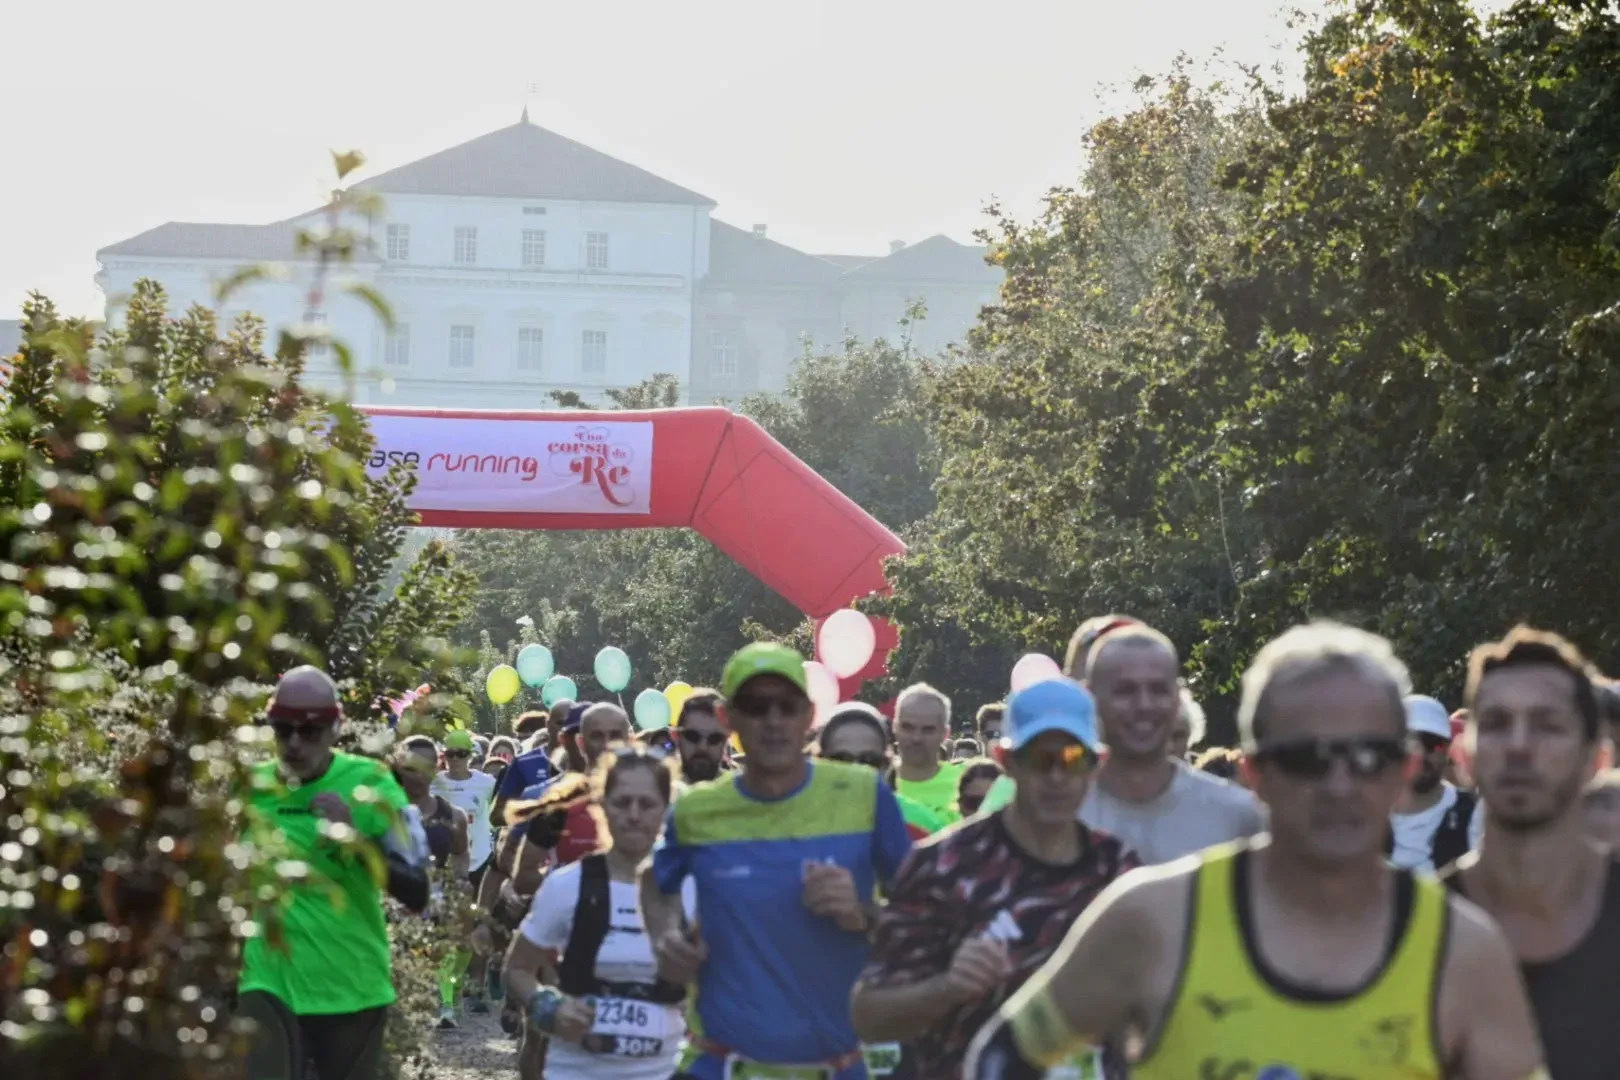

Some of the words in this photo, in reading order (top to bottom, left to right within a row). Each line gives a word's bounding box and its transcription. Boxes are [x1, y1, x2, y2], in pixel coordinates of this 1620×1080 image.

[547, 442, 608, 459] corsa
[364, 451, 420, 469] ase
[427, 453, 538, 481] running
[569, 455, 633, 507] Re
[599, 1001, 648, 1027] 2346
